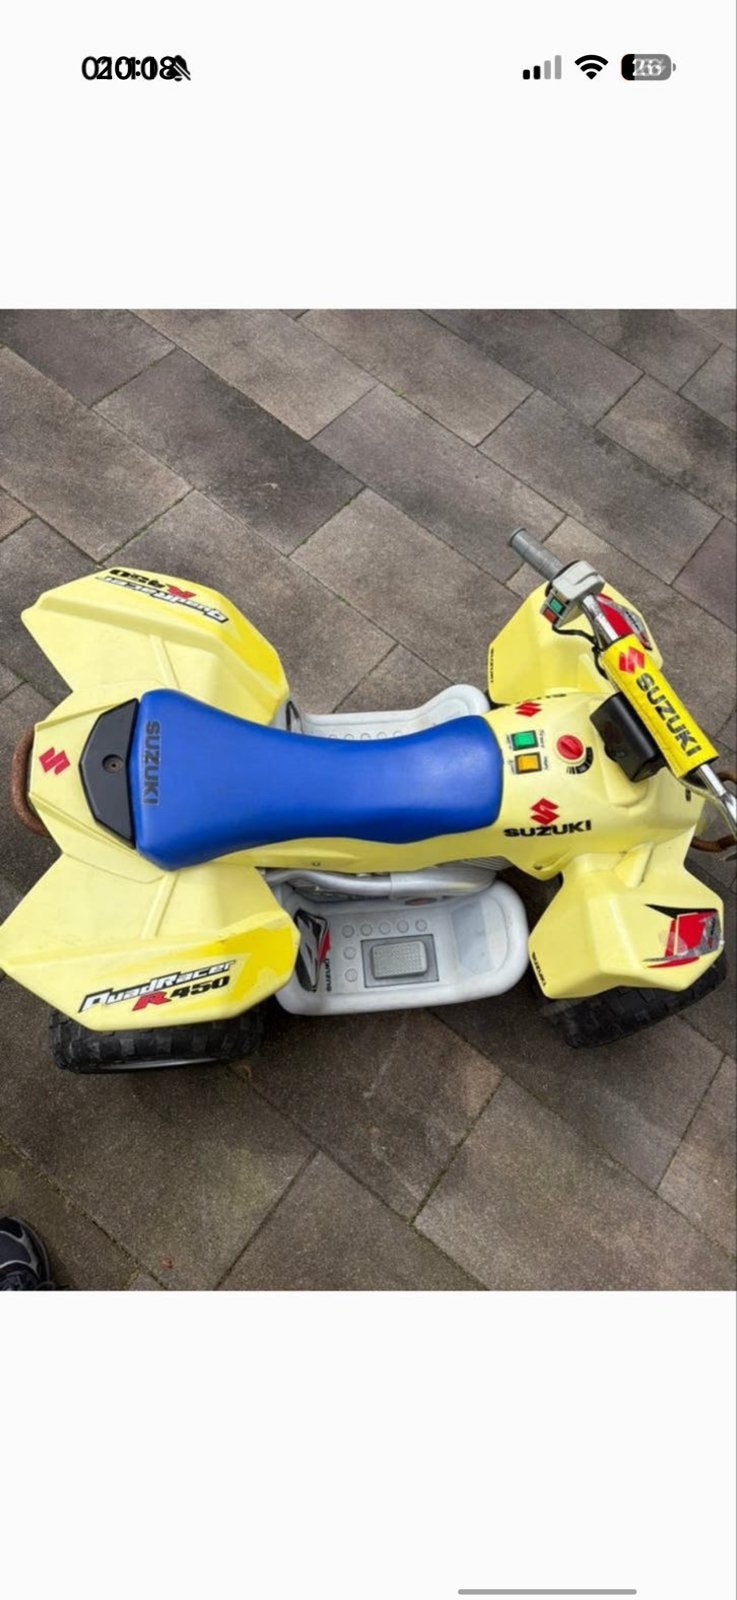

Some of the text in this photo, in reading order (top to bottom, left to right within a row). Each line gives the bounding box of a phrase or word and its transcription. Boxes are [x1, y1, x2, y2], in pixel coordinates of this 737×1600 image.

[636, 672, 702, 757] SUZUKI
[143, 720, 160, 804] SUZUKI
[503, 819, 592, 837] SUZUKI
